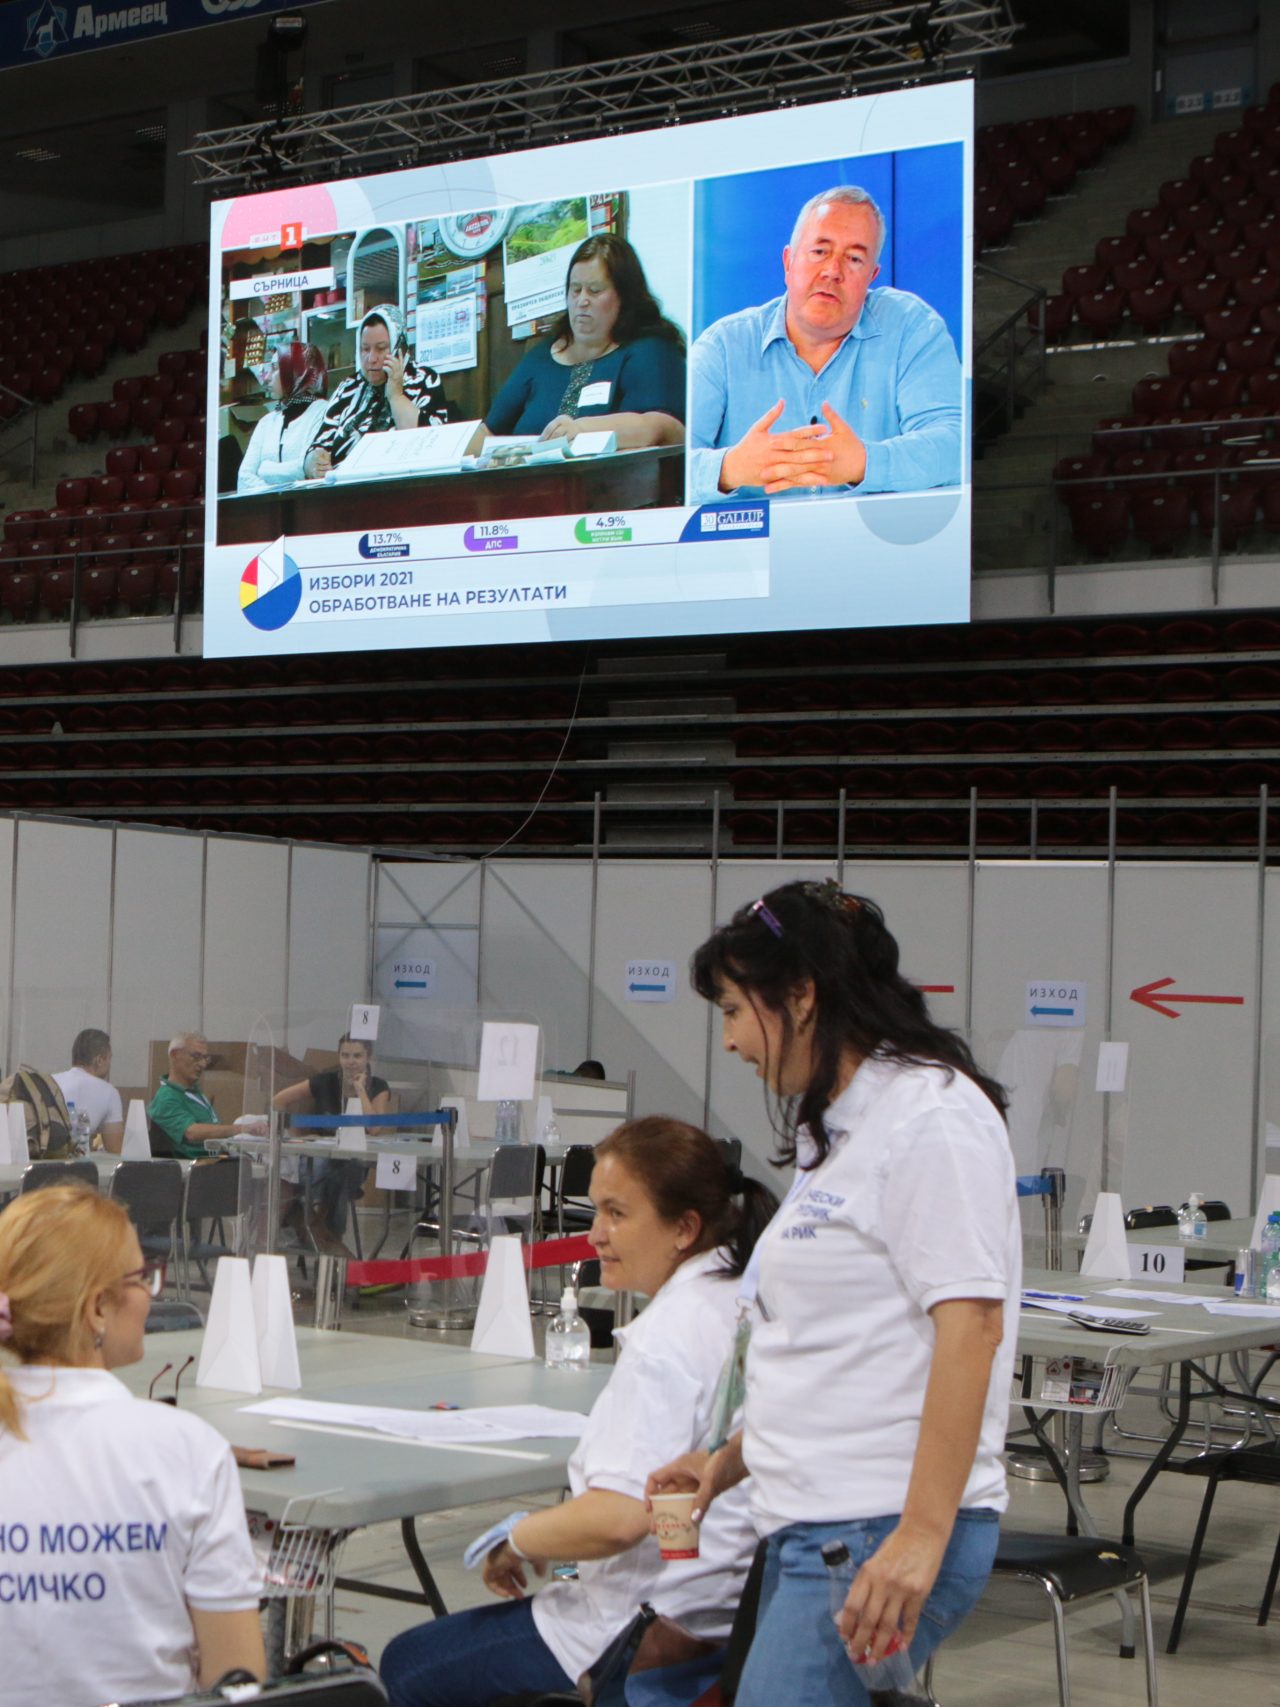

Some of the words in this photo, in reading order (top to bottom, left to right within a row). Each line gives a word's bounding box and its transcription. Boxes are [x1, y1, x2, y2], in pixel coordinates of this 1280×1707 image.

[73, 1, 168, 38] Армеец
[285, 226, 297, 246] 1
[253, 274, 309, 293] СЪРНИЦА
[596, 515, 626, 528] 4.9%
[717, 511, 764, 525] GALLUP
[480, 524, 509, 537] 11.8%
[373, 532, 402, 545] 13.7%
[485, 539, 503, 550] ДПС
[309, 573, 375, 591] ИЗБОРИ
[380, 571, 414, 587] 2021
[309, 593, 432, 613] ОБРАБОТВАНЕ
[437, 591, 461, 606] НА
[466, 585, 567, 605] РЕЗУЛТАТИ
[394, 964, 431, 975] ИЗХОД
[628, 966, 670, 977] ИЗХОД
[1029, 988, 1078, 1001] ИЗХОД
[362, 1010, 369, 1025] 8
[392, 1160, 401, 1175] 8
[1141, 1252, 1166, 1274] 10
[40, 1521, 168, 1555] МОЖЕМ
